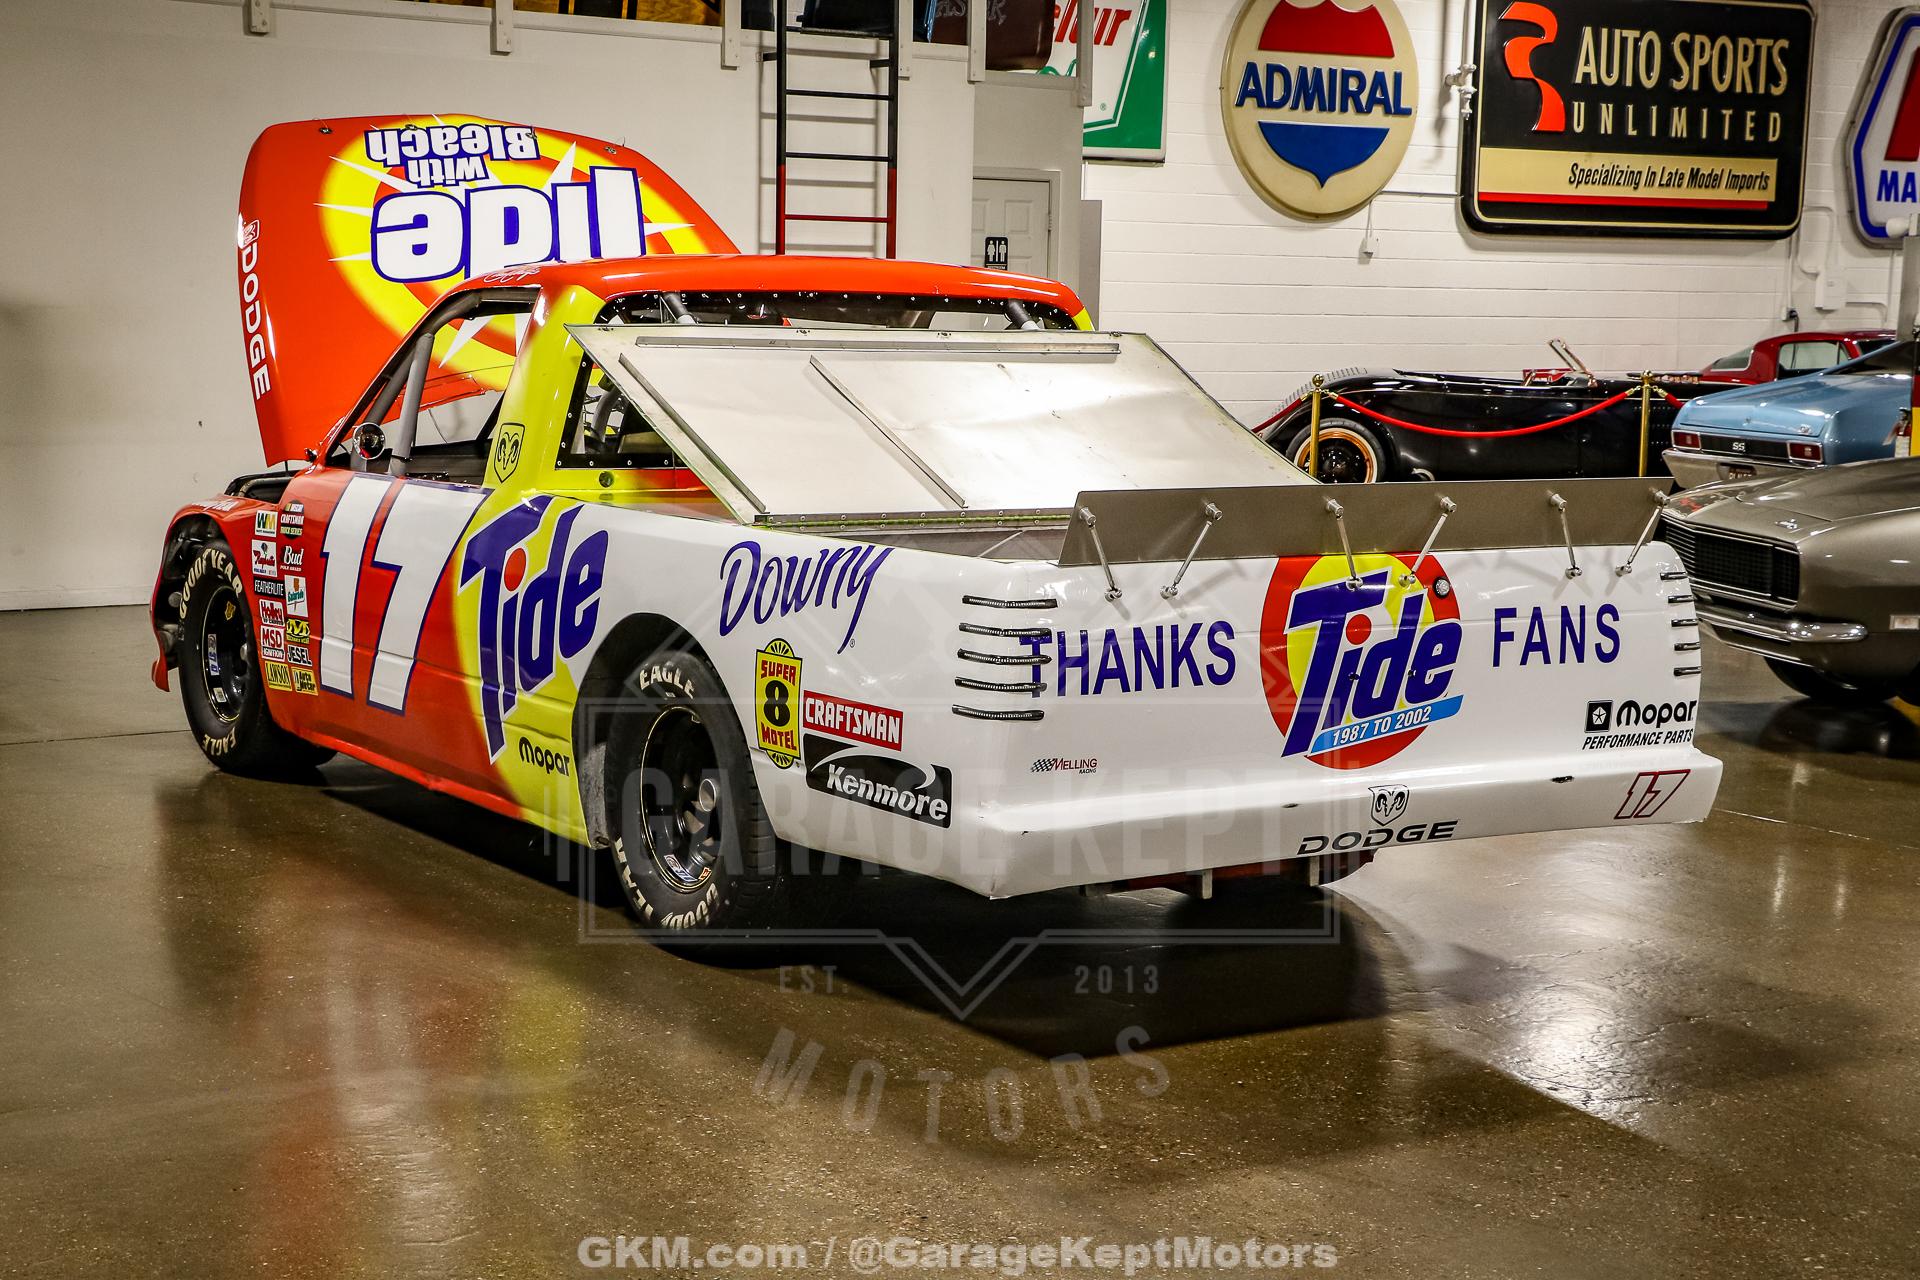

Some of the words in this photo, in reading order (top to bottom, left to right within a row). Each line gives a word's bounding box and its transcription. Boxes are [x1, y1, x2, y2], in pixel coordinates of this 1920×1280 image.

[1573, 26, 1661, 89] AUTO
[1670, 31, 1790, 96] SPORTS
[1234, 60, 1413, 116] ADMIRAL
[1573, 101, 1781, 142] UNLIMITED
[364, 124, 540, 167] Bleach
[405, 156, 490, 188] with
[1568, 162, 1643, 191] Specializing
[1643, 166, 1658, 187] In
[1658, 166, 1684, 188] Late
[1686, 167, 1724, 190] Model
[1724, 169, 1770, 193] Imports
[242, 242, 271, 401] DODGE
[284, 545, 304, 566] Bud
[254, 579, 284, 597] FEATHERLITE
[320, 472, 495, 716] 17
[719, 540, 895, 655] Downy
[262, 627, 283, 649] MSD
[457, 495, 610, 766] Tide
[266, 662, 291, 685] LAWSON
[288, 645, 312, 665] JESEL
[760, 660, 797, 686] SUPER
[1018, 620, 1236, 699] THANKS
[1281, 570, 1463, 757] Tide
[1492, 603, 1621, 668] FANS
[639, 665, 695, 700] EAGLE
[763, 680, 791, 727] 8
[805, 697, 901, 744] CRAFTSMAN
[760, 722, 798, 751] MOTEL
[1332, 722, 1370, 746] 1987
[1372, 716, 1392, 736] TO
[1393, 705, 1432, 730] 2002
[1582, 731, 1664, 750] PERFORMANCE
[1663, 728, 1694, 745] PARTS
[1051, 757, 1098, 771] MELLING
[1078, 767, 1097, 775] RACING
[826, 763, 949, 821] Kenmore
[1613, 769, 1691, 820] 17
[1297, 820, 1458, 856] DODGE
